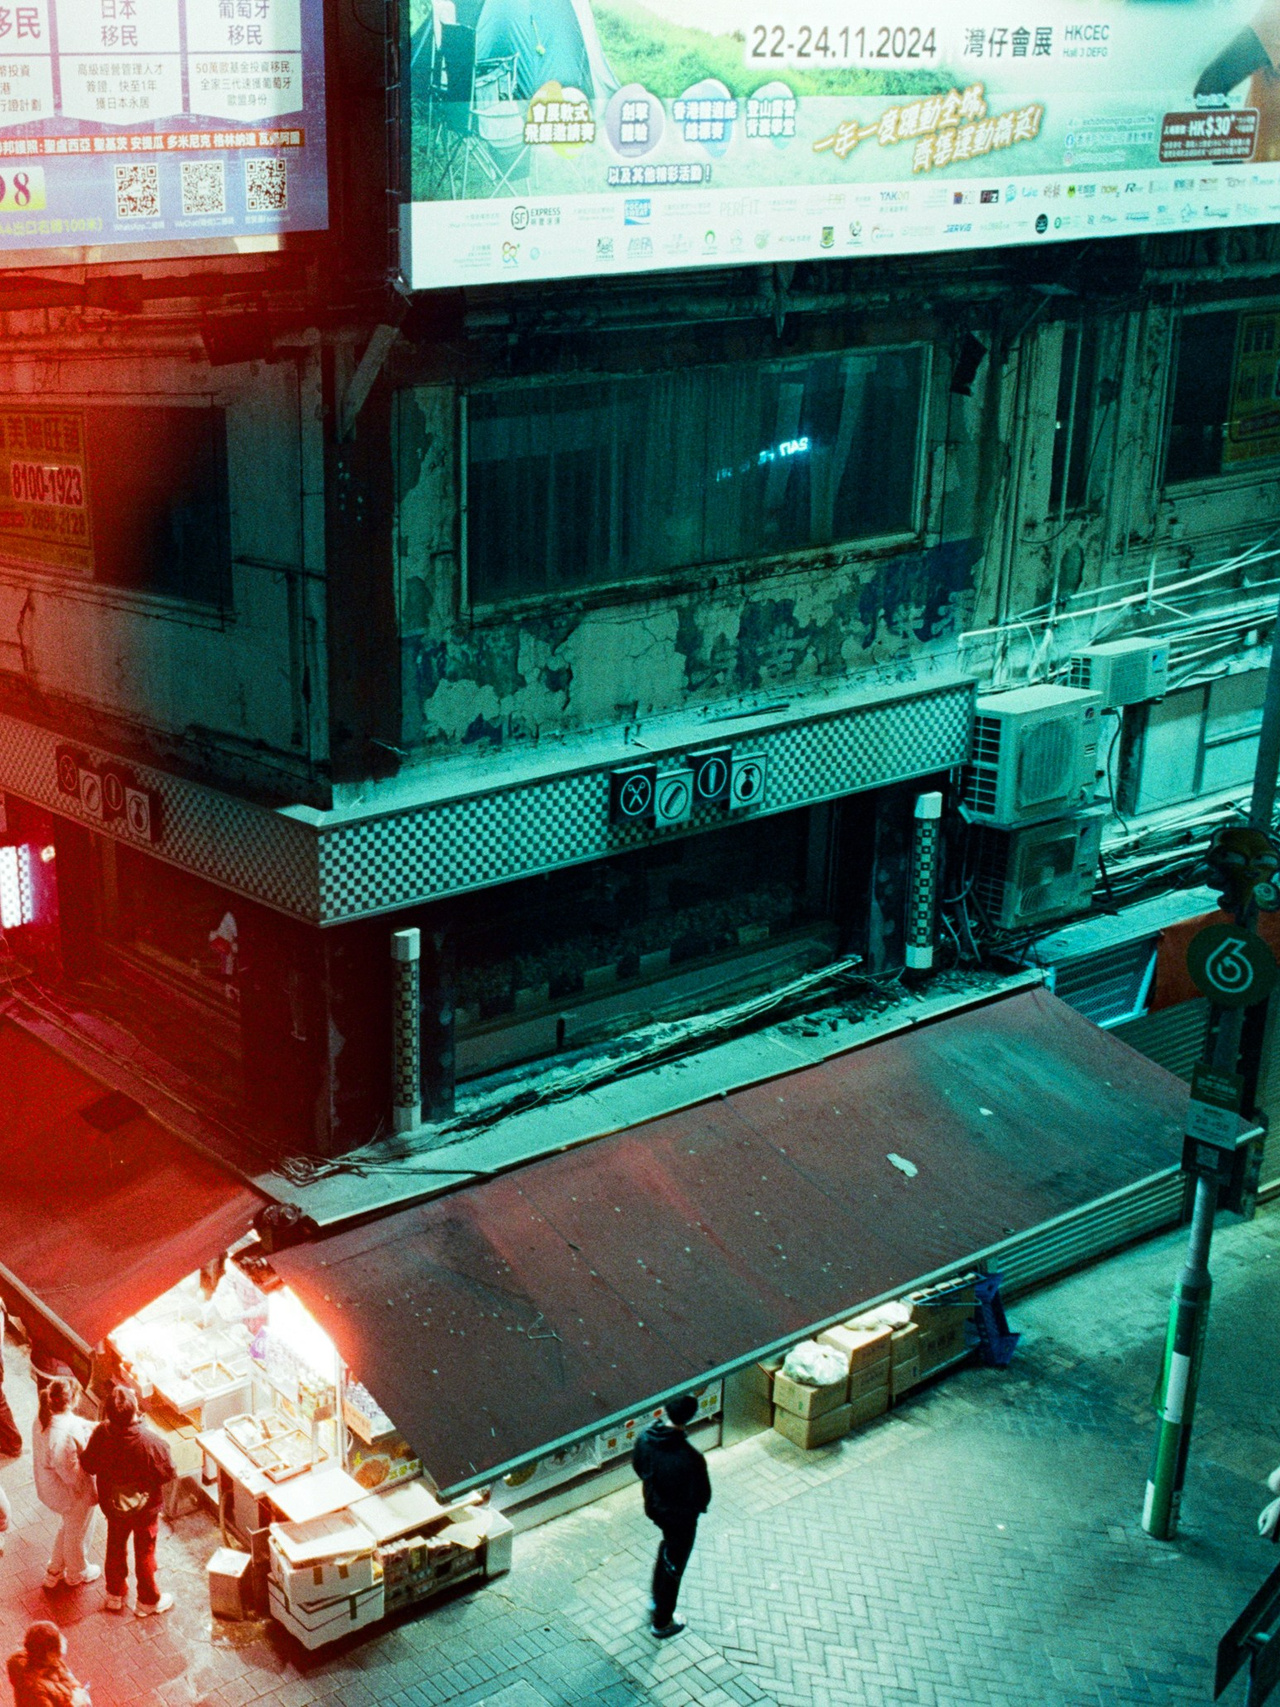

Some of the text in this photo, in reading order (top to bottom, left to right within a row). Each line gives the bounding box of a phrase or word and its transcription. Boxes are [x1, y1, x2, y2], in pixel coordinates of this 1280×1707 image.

[101, 25, 138, 47] 移民
[228, 24, 262, 46] 移民
[752, 25, 936, 58] 22-24.11.2024
[963, 26, 1053, 58] 灣仔會展
[1064, 24, 1110, 41] HKCEC
